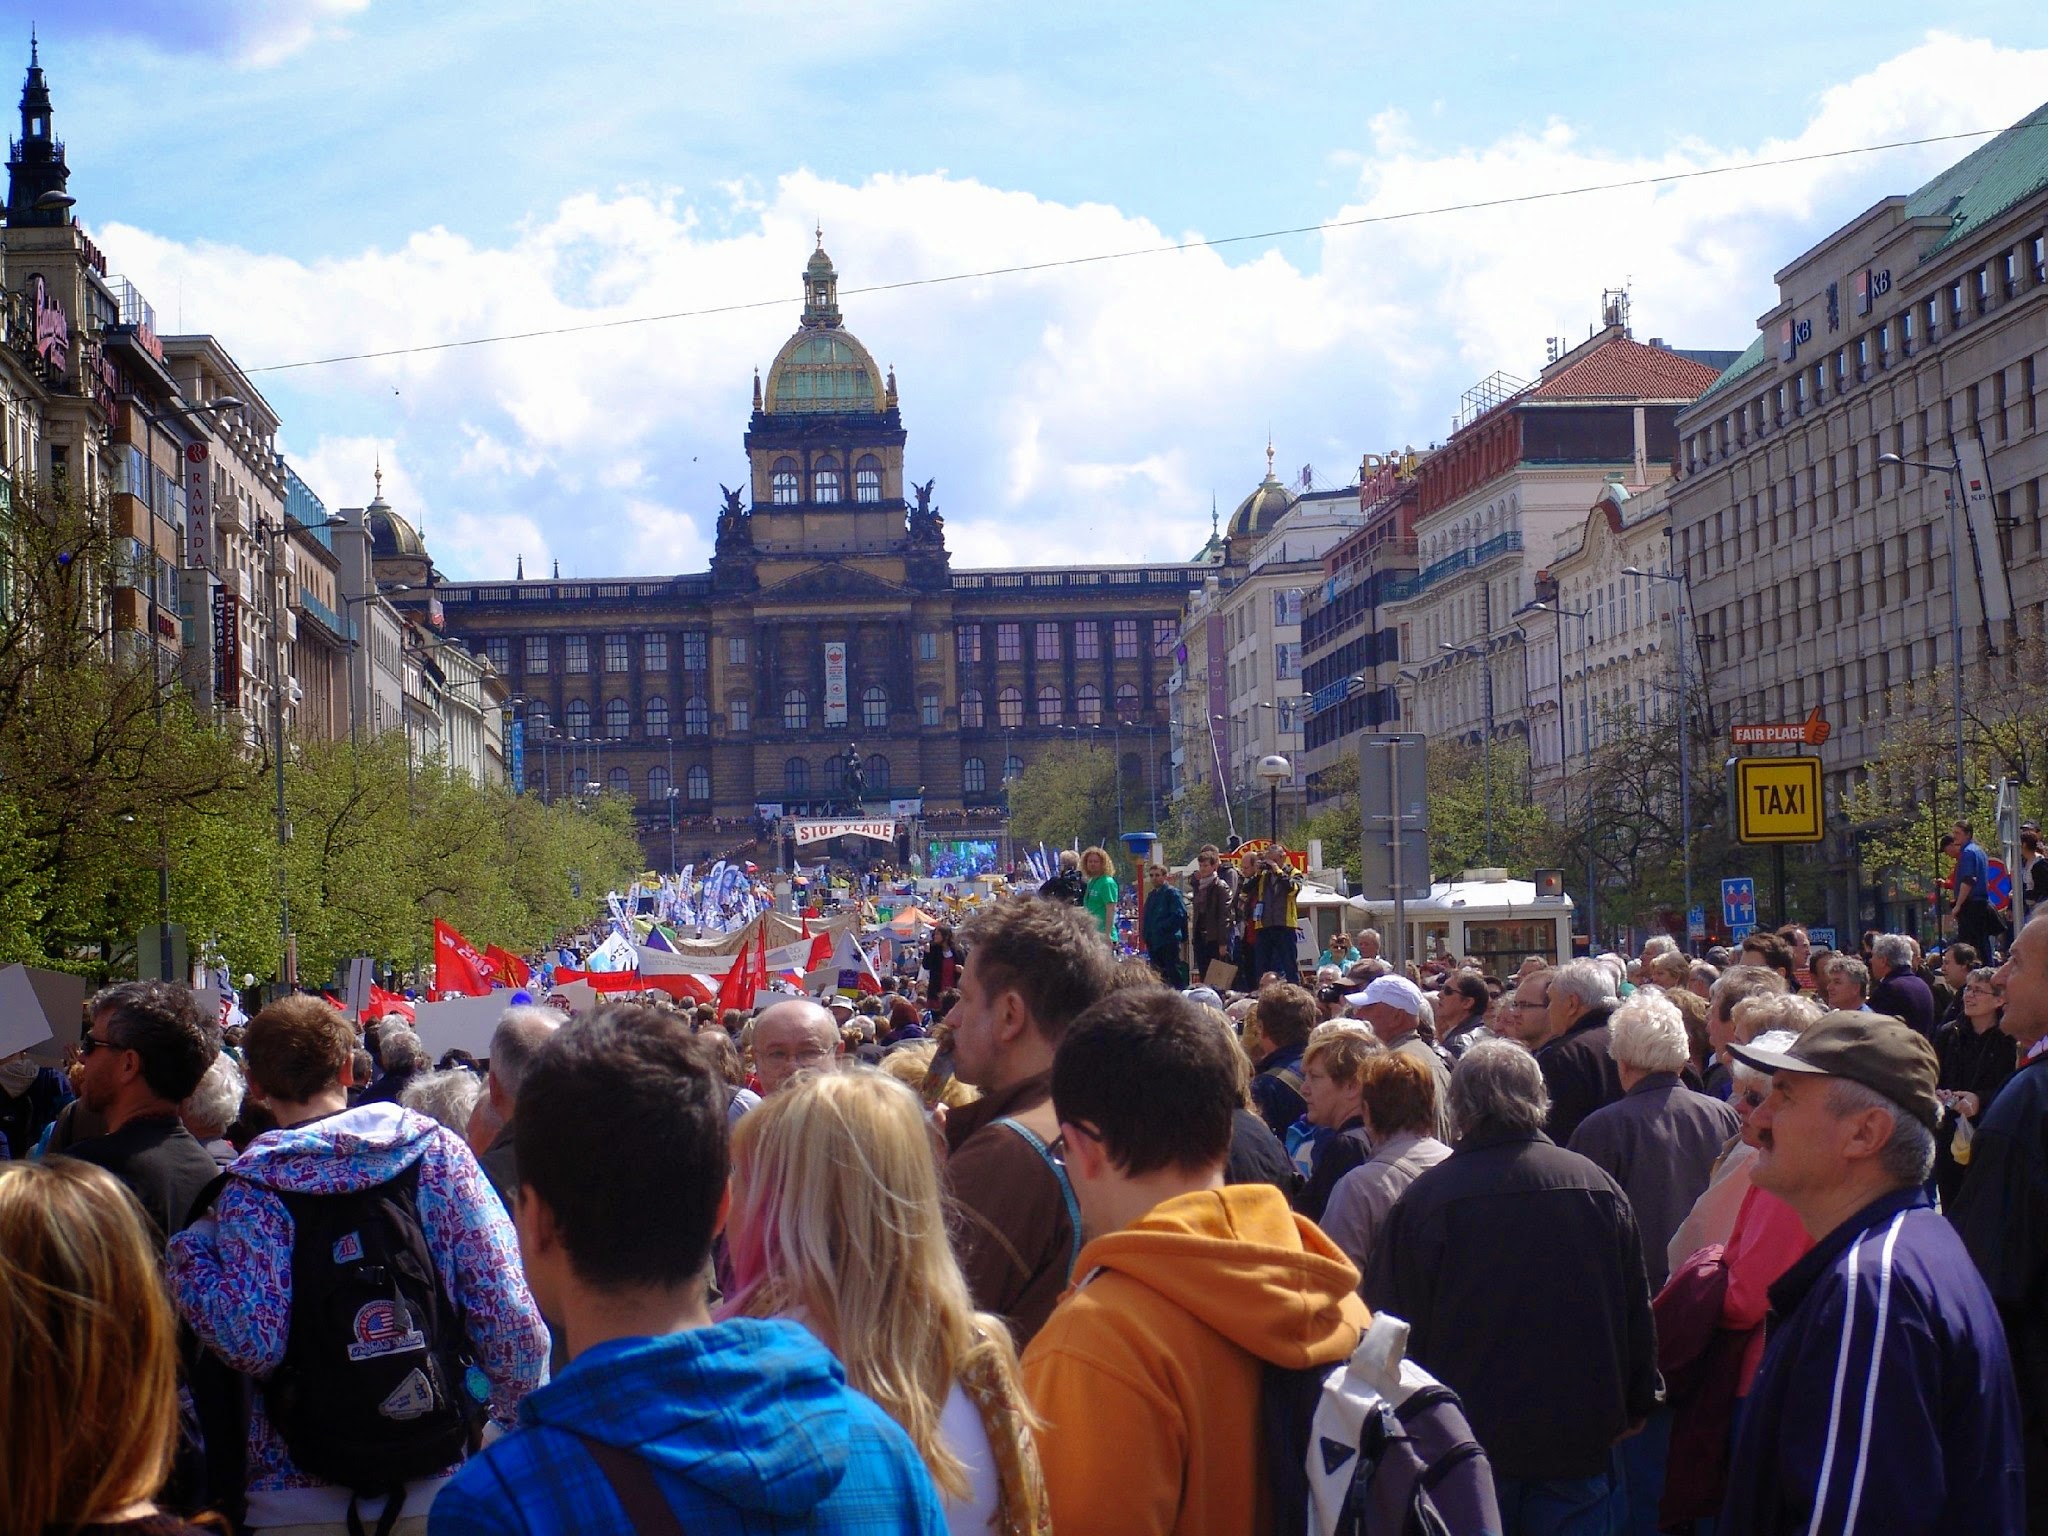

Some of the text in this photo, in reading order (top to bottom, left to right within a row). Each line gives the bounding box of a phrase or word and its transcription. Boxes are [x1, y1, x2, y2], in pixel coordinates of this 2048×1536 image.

[1871, 269, 1891, 298] KB
[1794, 319, 1811, 346] KB
[1970, 493, 1986, 501] KB
[191, 472, 205, 565] RAMADA
[1736, 727, 1806, 741] FAIR PLACE
[1753, 784, 1806, 815] TAXI
[800, 825, 838, 840] STOP
